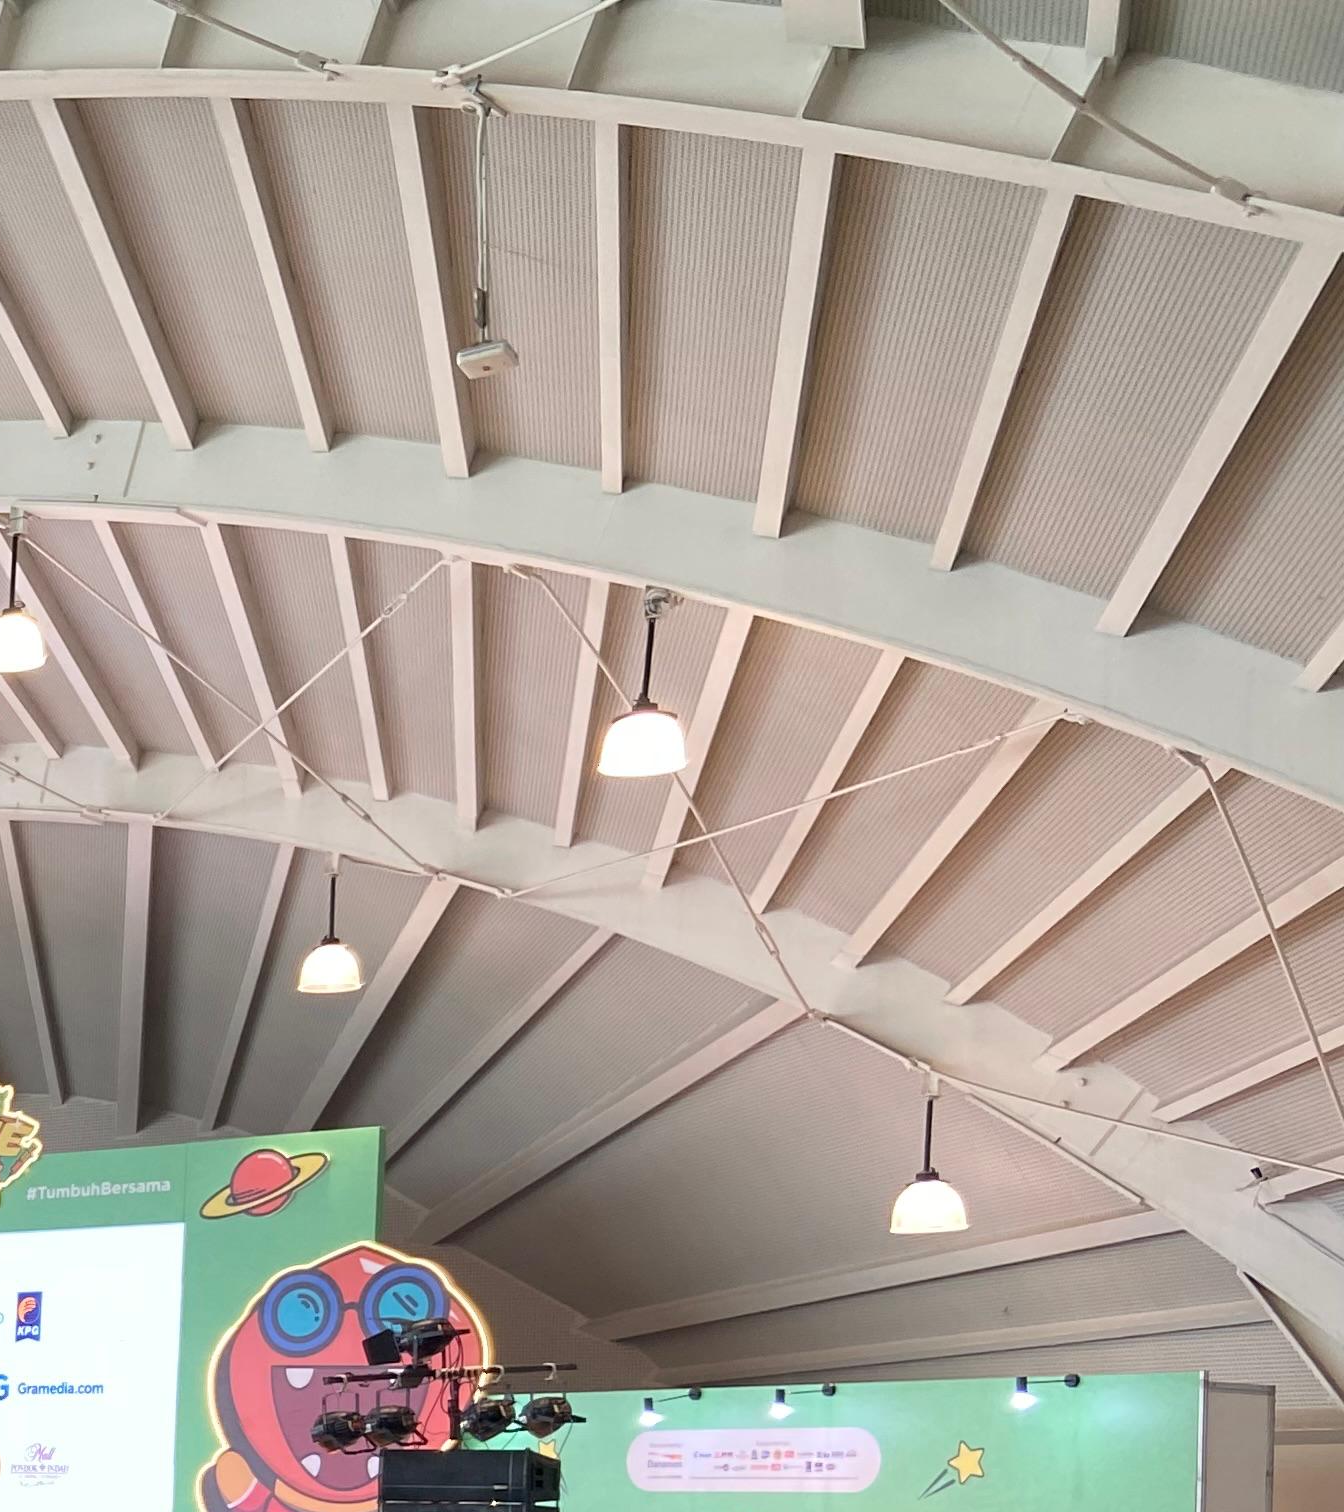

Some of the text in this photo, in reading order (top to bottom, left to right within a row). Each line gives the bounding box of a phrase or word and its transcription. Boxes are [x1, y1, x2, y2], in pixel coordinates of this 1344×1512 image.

[26, 1180, 173, 1202] #TumbuhBersama
[16, 1325, 40, 1337] KPG
[17, 1381, 105, 1396] Gramedia.com
